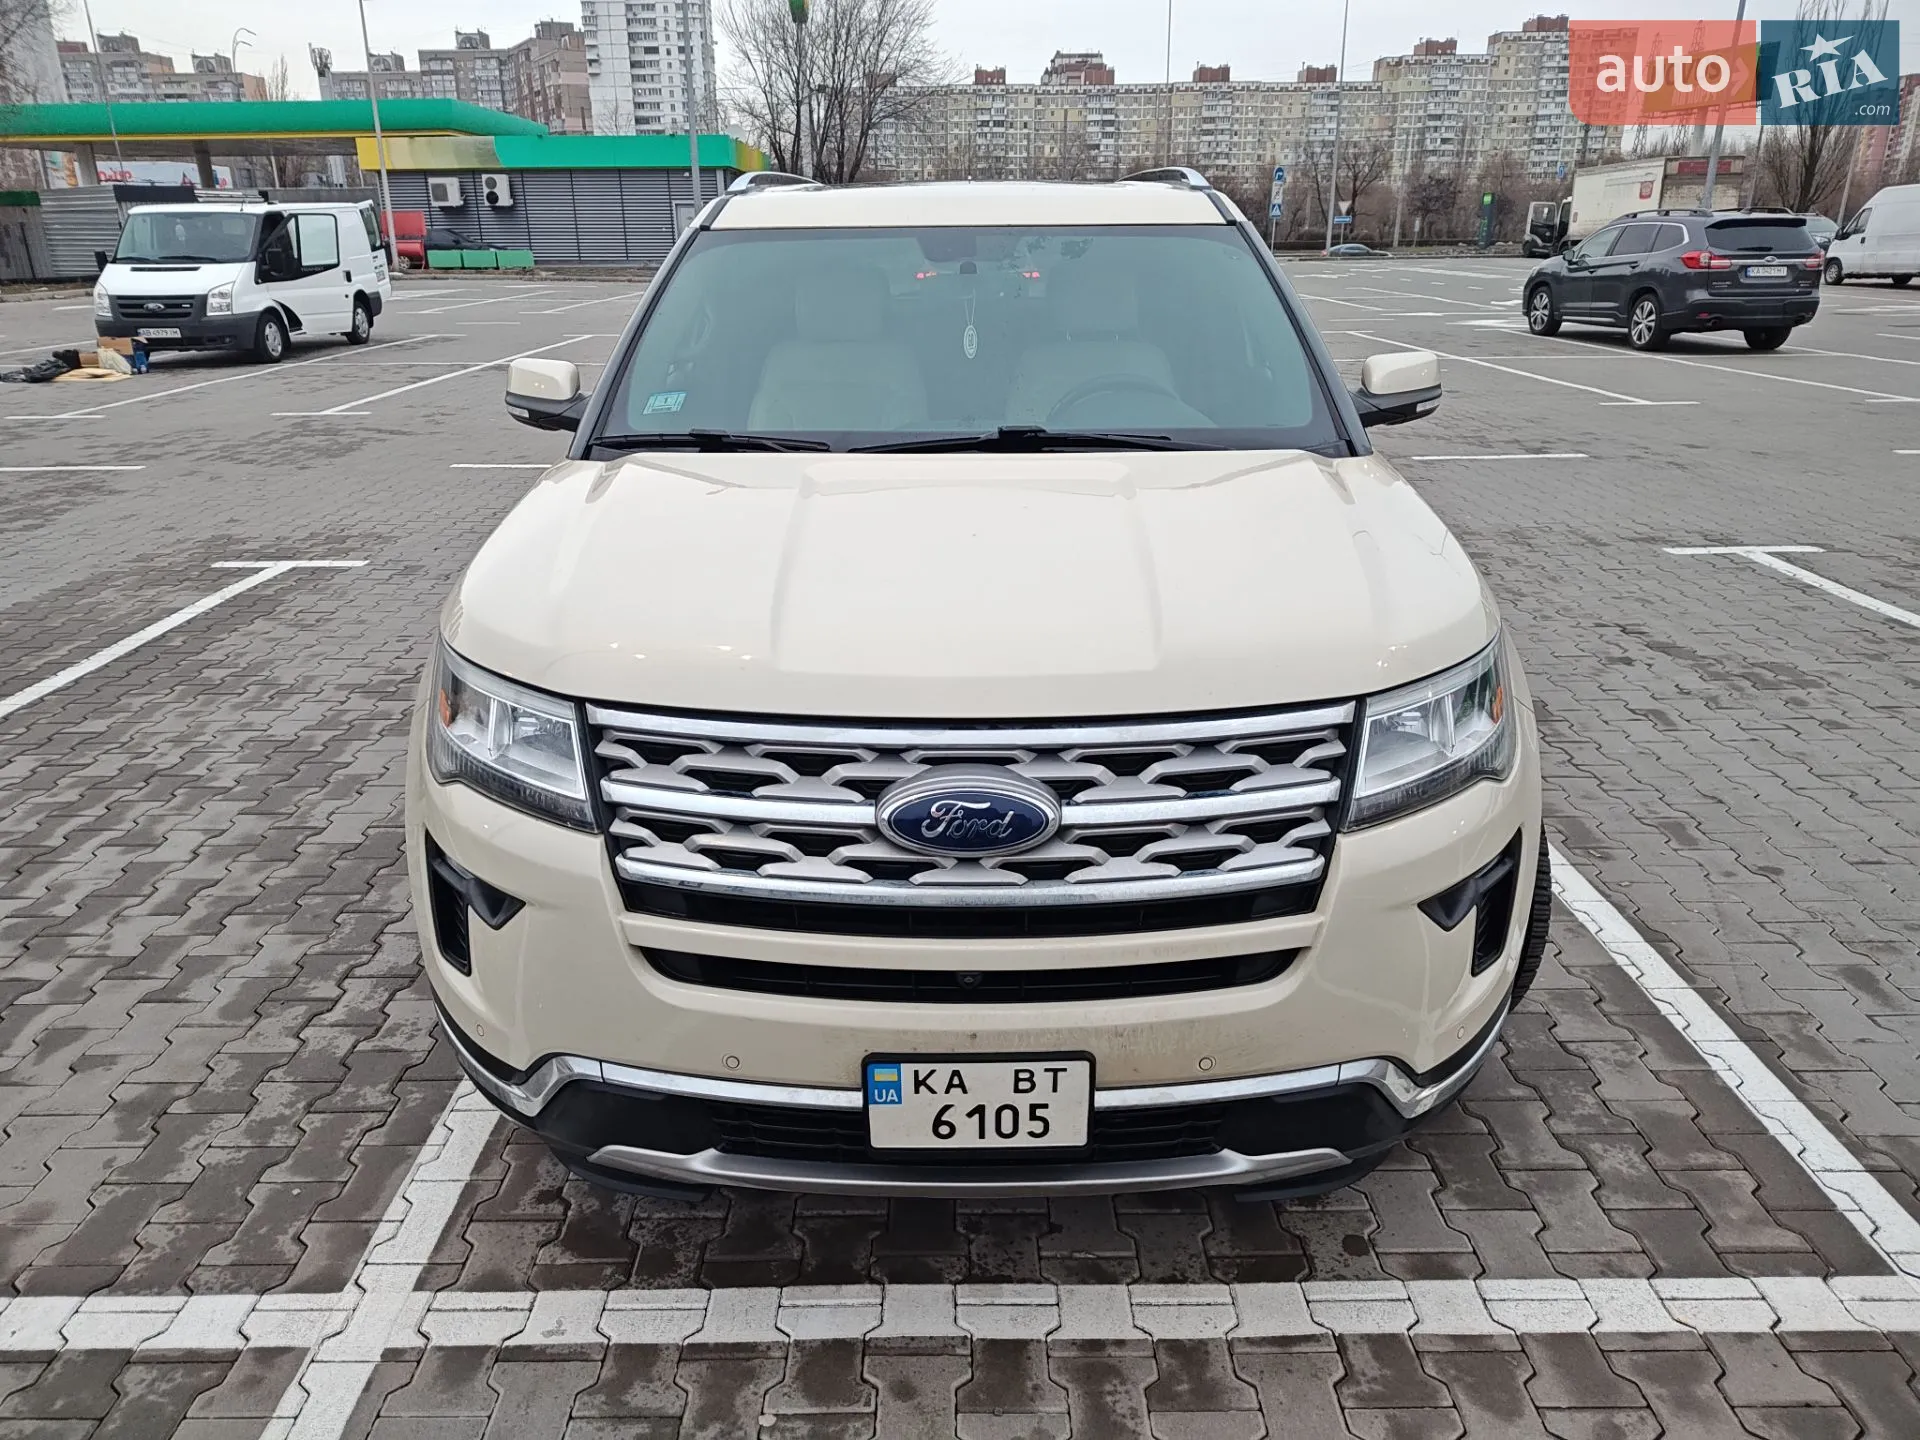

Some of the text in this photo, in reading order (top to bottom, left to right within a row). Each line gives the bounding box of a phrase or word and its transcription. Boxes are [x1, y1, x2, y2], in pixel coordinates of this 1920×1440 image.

[921, 800, 1014, 838] Ford
[874, 1089, 898, 1102] UA
[913, 1068, 1067, 1094] KA BT
[932, 1104, 1050, 1139] 6105
